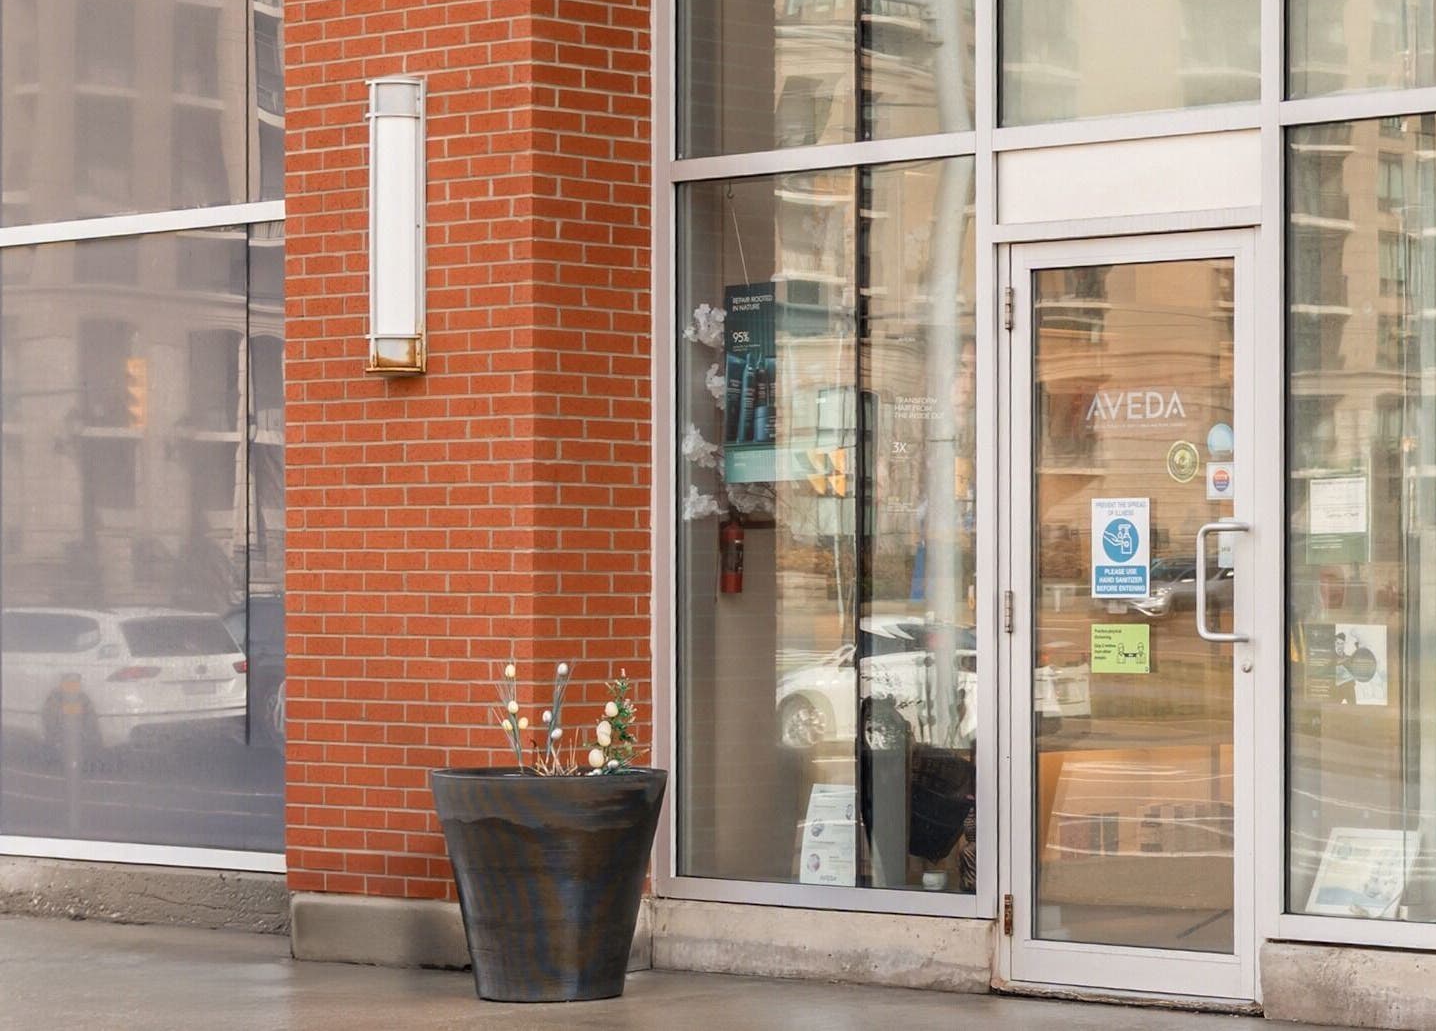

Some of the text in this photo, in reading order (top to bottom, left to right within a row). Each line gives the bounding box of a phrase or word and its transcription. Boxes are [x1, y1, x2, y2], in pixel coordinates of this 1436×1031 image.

[732, 331, 750, 342] 95%
[1086, 390, 1187, 420] AVEDA
[892, 442, 907, 453] 3X
